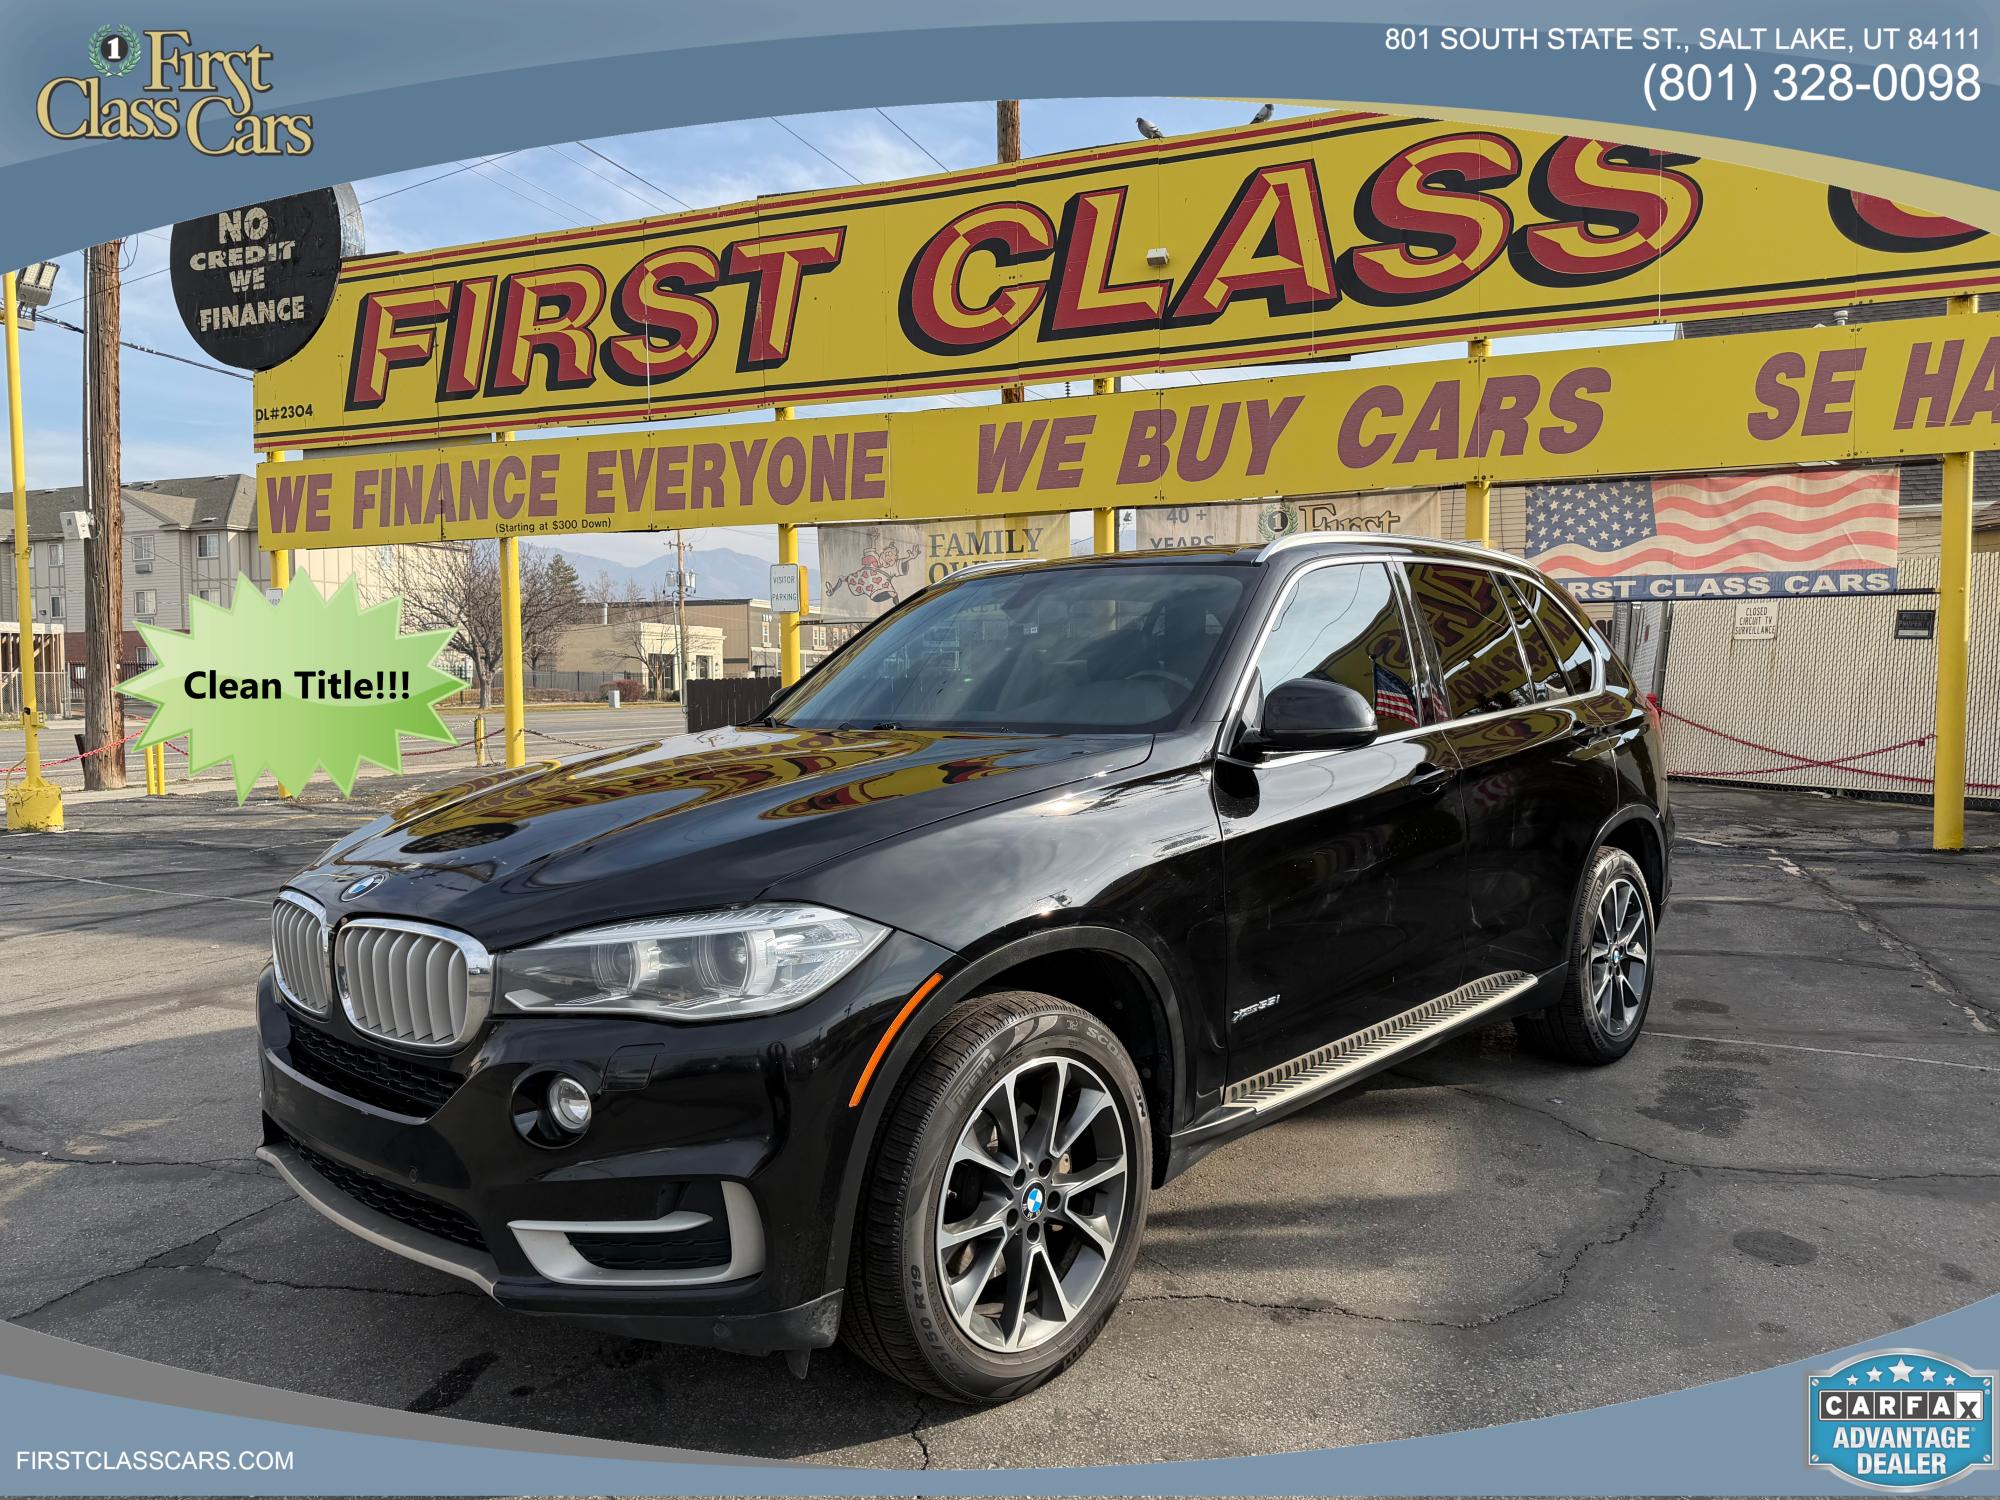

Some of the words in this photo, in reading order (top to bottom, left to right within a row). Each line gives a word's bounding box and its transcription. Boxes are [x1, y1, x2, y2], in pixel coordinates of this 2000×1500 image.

[217, 206, 269, 244] NO
[189, 240, 296, 271] CREDIT
[228, 266, 266, 293] WE
[344, 225, 848, 412] FIRST
[898, 131, 1704, 356] CLASS
[199, 295, 305, 333] FINANCE
[1747, 347, 1867, 440] SE
[255, 403, 313, 423] DL#2304
[977, 414, 1097, 495] WE
[1116, 395, 1305, 485] BUY
[1337, 367, 1612, 469] CARS
[266, 473, 332, 533] WE
[352, 452, 561, 530] FINANCE
[585, 430, 889, 515] EVERYONE
[495, 522, 535, 533] (Starting
[540, 522, 548, 530] at
[552, 519, 578, 530] $300
[581, 517, 611, 529] Down)
[1167, 508, 1190, 524] 40
[928, 527, 1044, 558] FAMILY
[1150, 536, 1214, 549] YEARS
[773, 575, 795, 584] VISITOR
[1560, 580, 1637, 599] RST
[1649, 574, 1770, 597] CLASS
[1784, 573, 1890, 594] CARS
[772, 592, 797, 601] PARKING
[1739, 617, 1761, 626] CIRCUIT
[1765, 616, 1773, 625] TV
[1745, 606, 1768, 616] CLOSED
[1735, 625, 1775, 635] SURVEILLANCE
